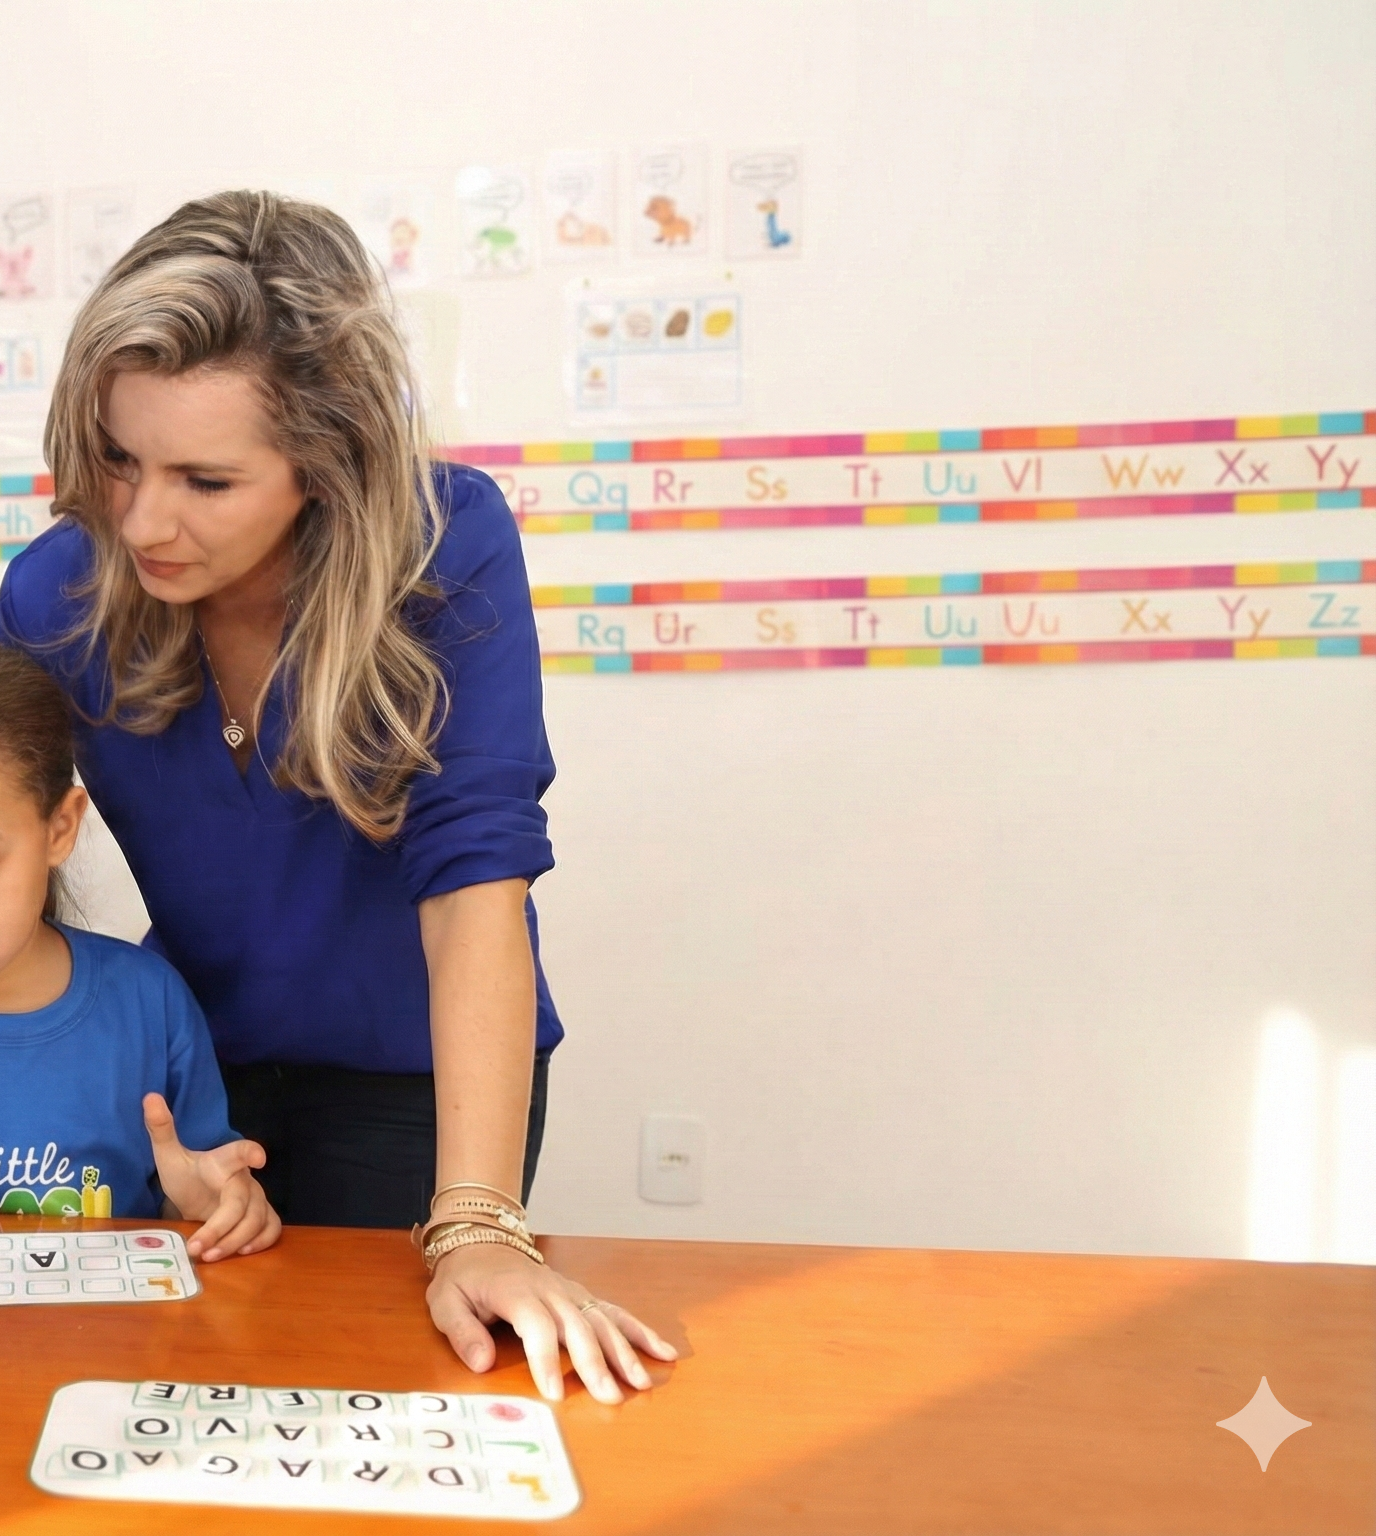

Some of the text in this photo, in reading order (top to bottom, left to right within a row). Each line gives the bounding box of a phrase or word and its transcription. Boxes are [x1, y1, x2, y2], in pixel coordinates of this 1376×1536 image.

[568, 471, 628, 513] Qq
[653, 469, 694, 502] Rr
[746, 466, 788, 501] Ss
[845, 464, 883, 498] Tt
[924, 461, 977, 495] Uu
[1102, 453, 1185, 489] Ww
[1216, 449, 1269, 485] Xx
[1307, 445, 1360, 492] Yy
[756, 609, 797, 642] Ss
[844, 607, 880, 641] Tt
[924, 605, 977, 638] Uu
[1122, 599, 1172, 632] Xx
[1218, 595, 1270, 640] Yy
[1309, 593, 1360, 628] Zz
[29, 1251, 57, 1268] A
